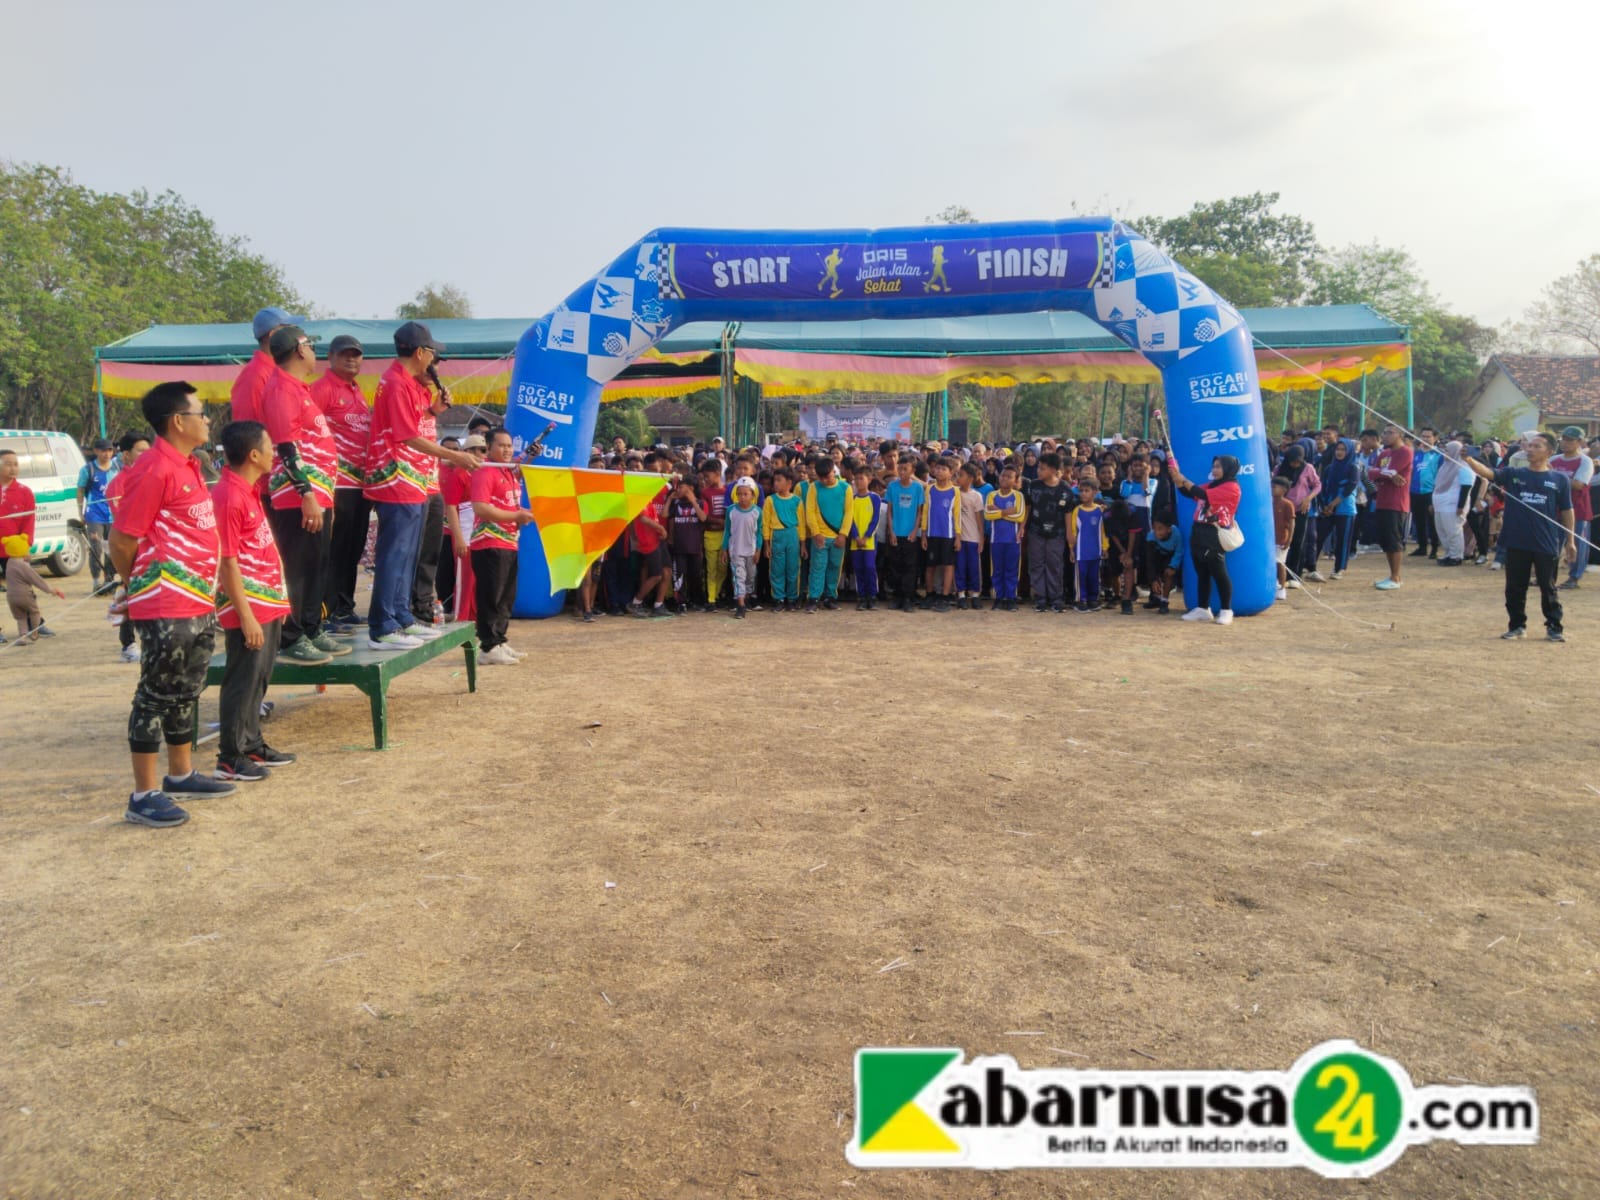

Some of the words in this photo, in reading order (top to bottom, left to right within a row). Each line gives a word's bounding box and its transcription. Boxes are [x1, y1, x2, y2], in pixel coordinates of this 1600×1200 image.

[712, 256, 791, 288] START
[855, 265, 887, 281] Jalan
[888, 262, 921, 277] Jalan
[977, 247, 1068, 280] FINISH
[864, 278, 902, 294] Sehat
[1189, 371, 1249, 390] POCARI
[518, 384, 575, 404] POCARI
[1191, 382, 1246, 400] SWEAT
[517, 394, 569, 412] SWEAT
[1201, 425, 1254, 445] 2XU
